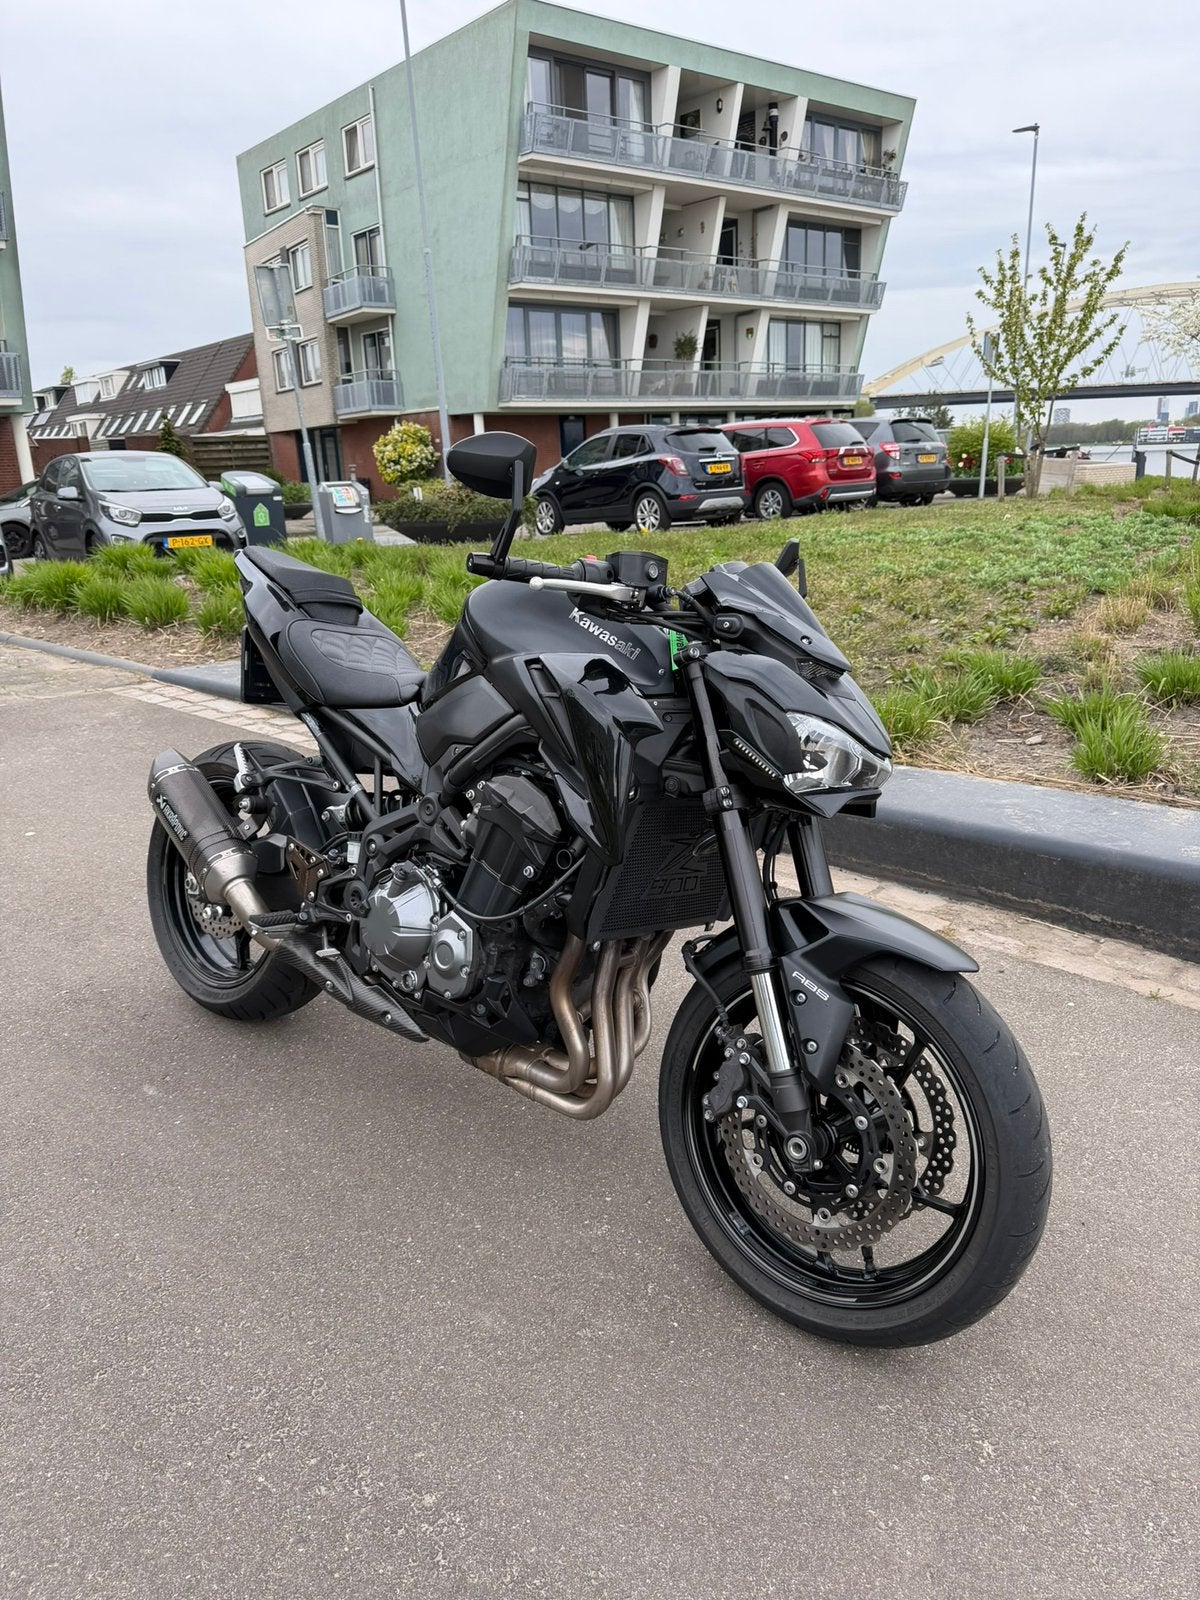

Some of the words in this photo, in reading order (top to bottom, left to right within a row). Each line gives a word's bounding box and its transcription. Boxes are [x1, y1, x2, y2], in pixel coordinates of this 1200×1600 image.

[172, 536, 210, 547] P-162-GX
[568, 606, 641, 661] Kawasaki
[792, 971, 830, 1001] ABS
